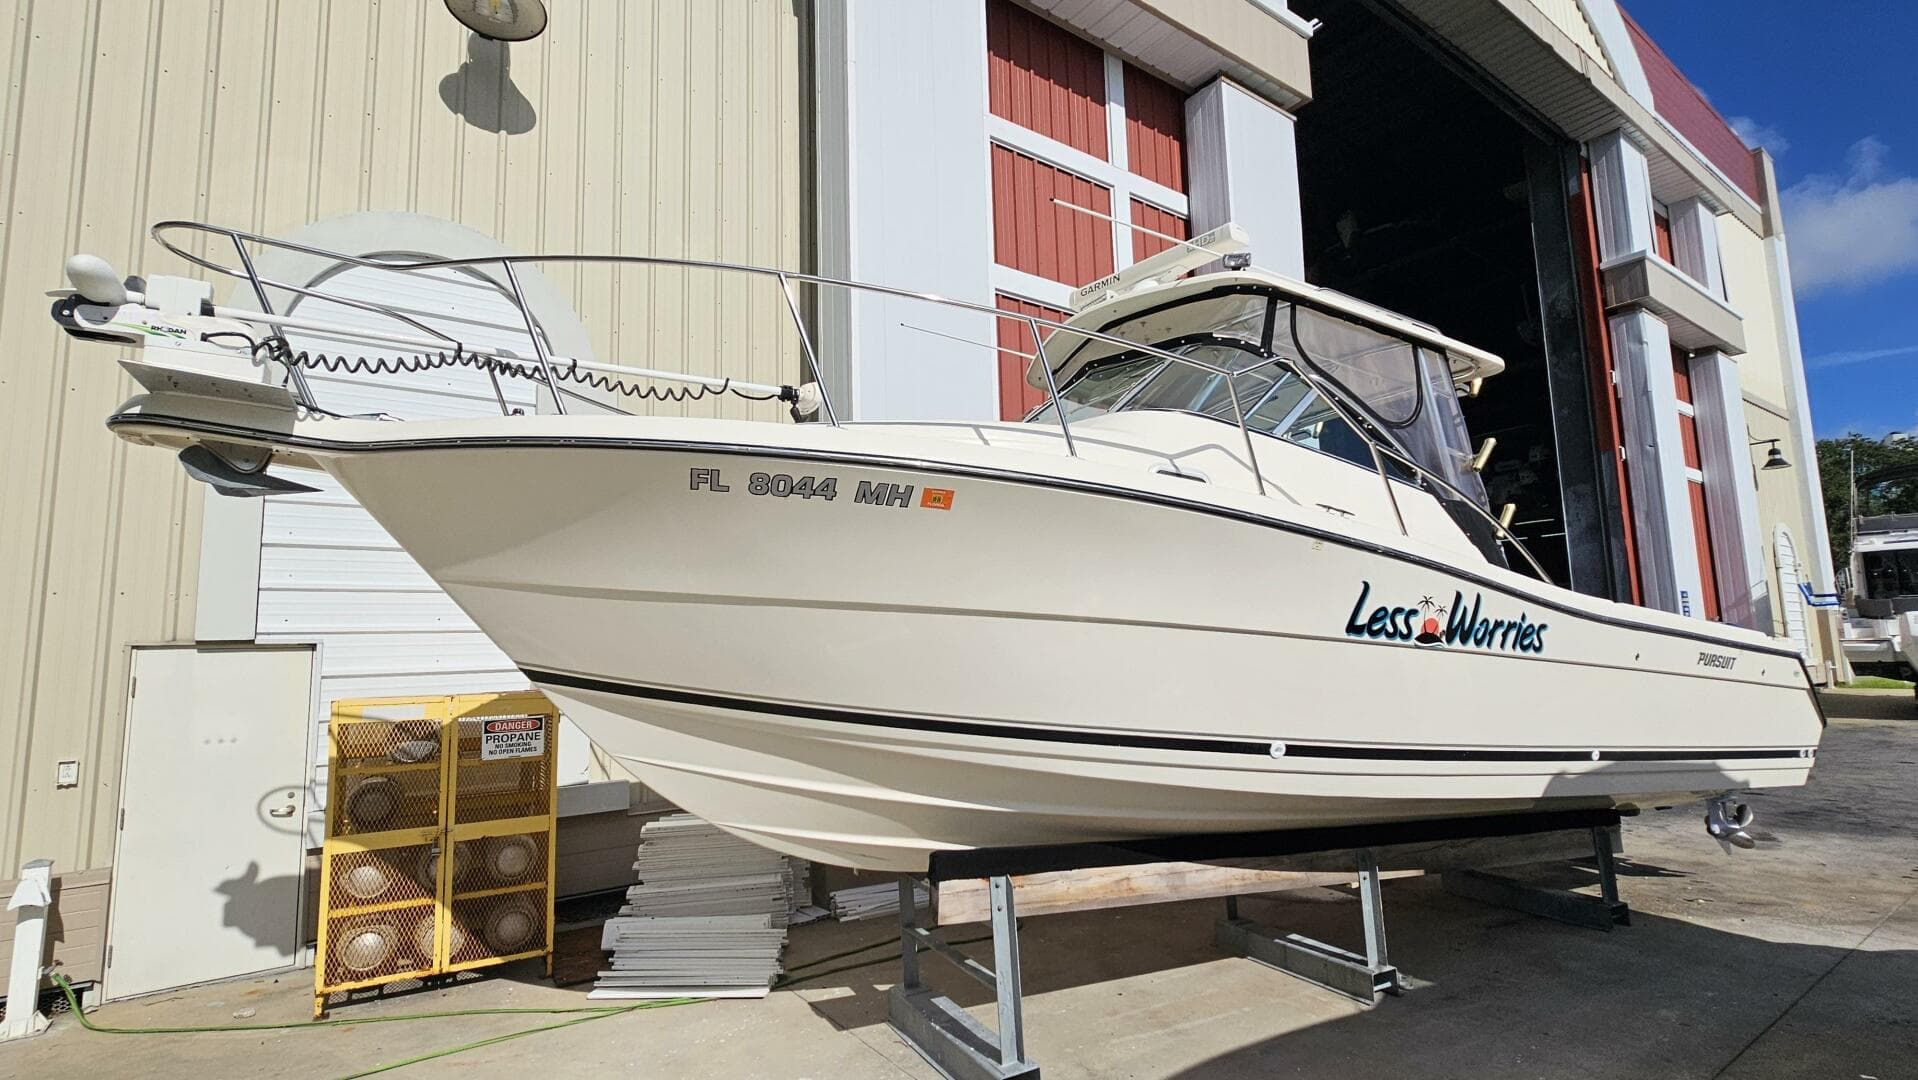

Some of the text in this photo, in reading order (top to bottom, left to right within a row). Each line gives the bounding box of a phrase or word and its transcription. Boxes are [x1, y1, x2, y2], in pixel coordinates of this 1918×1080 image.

[1080, 274, 1121, 297] GARMIN
[690, 468, 914, 508] FL 8044 MH
[1345, 580, 1549, 654] Less Worries
[1697, 651, 1737, 670] PURSUIT
[495, 720, 532, 731] DANGER
[485, 732, 541, 744] PROPANE
